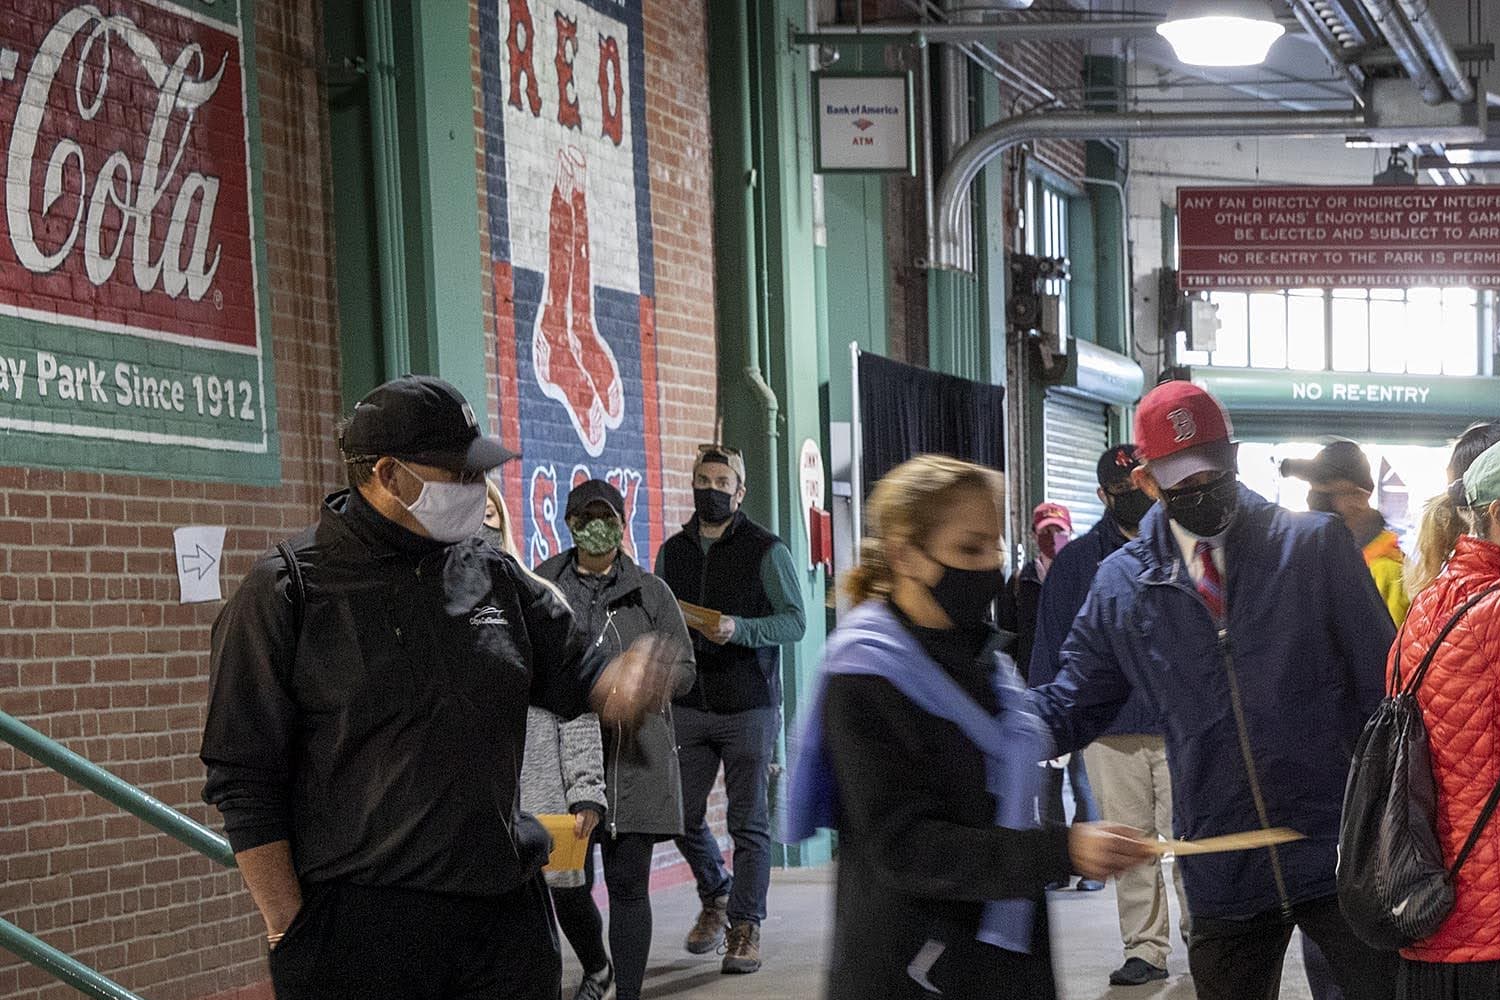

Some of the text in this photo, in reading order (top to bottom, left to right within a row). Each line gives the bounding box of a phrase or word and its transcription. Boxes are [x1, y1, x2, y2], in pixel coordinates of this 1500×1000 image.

[506, 0, 624, 147] RED
[826, 104, 899, 114] Bank of America
[852, 137, 874, 145] ATM
[1184, 197, 1213, 209] ANY
[1219, 197, 1246, 209] FAN
[1252, 197, 1320, 209] DIRECTLY
[1326, 196, 1347, 208] OR
[1353, 196, 1438, 208] INDIRECTLY
[1214, 212, 1262, 224] OTHER
[1269, 211, 1309, 224] FANS'
[1315, 212, 1403, 224] ENJOYMENT
[1408, 211, 1426, 223] OF
[1433, 211, 1462, 223] THE
[1234, 228, 1256, 240] BE
[1260, 228, 1327, 240] EJECTED
[1332, 228, 1364, 240] AND
[1369, 228, 1438, 240] SUBJECT
[1443, 227, 1462, 239] TO
[1218, 252, 1238, 264] NO
[1245, 252, 1318, 264] RE-ENTRY
[1323, 252, 1343, 264] TO
[1349, 252, 1377, 264] THE
[1384, 252, 1424, 264] PARK
[1431, 252, 1446, 264] IS
[1186, 275, 1213, 286] THE
[1217, 275, 1272, 286] BOSTON
[1275, 275, 1304, 286] RED
[1307, 275, 1337, 286] SOX
[1339, 275, 1427, 286] APPRECIATE
[1431, 275, 1469, 286] YOUR
[37, 351, 109, 403] Park
[114, 361, 185, 412] Since
[192, 375, 255, 420] 1912
[1292, 383, 1430, 403] NO RE-ENTRY
